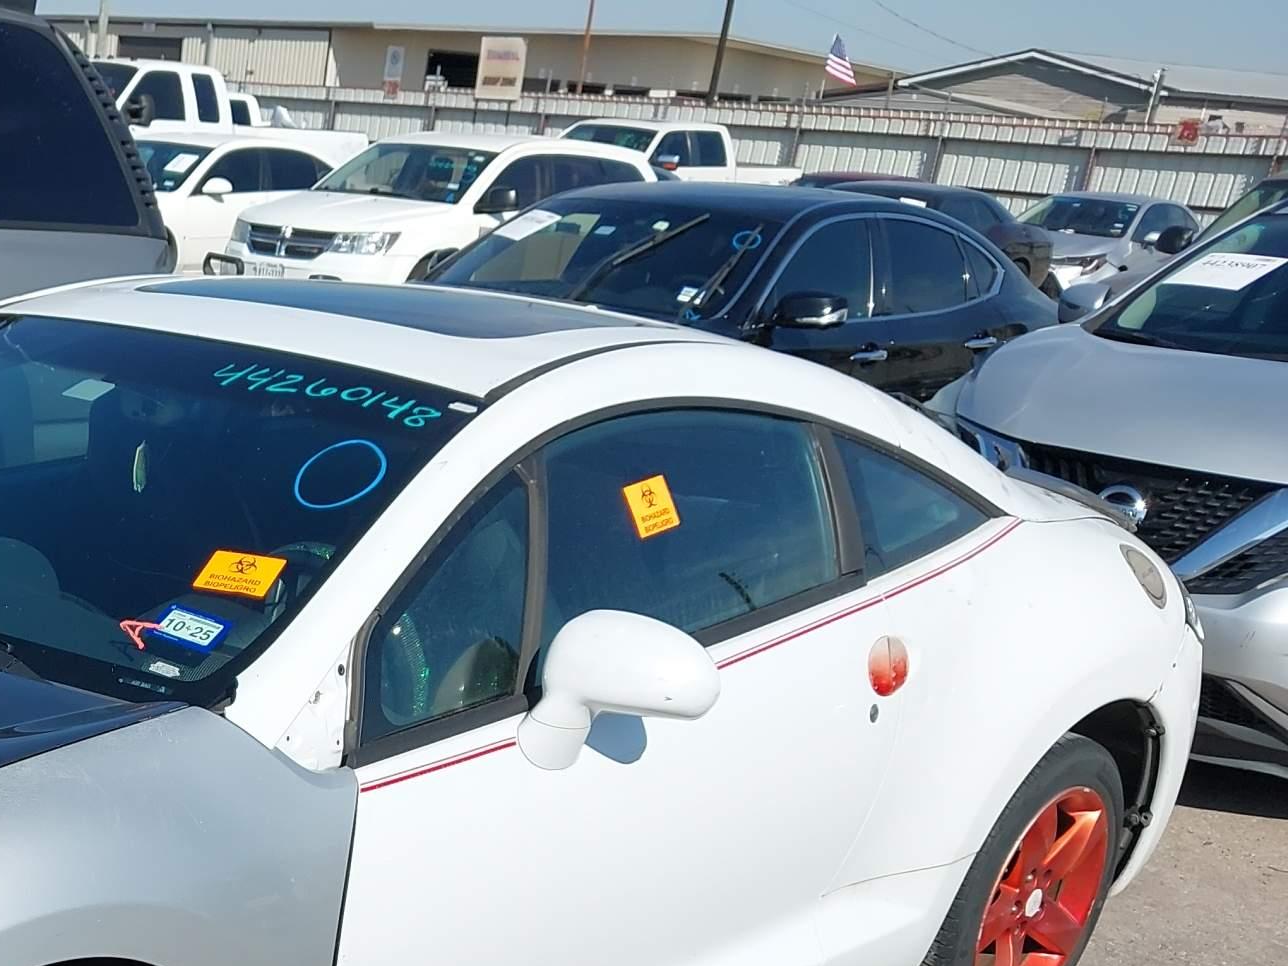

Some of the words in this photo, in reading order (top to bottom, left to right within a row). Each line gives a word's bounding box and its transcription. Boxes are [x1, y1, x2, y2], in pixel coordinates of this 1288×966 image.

[213, 363, 442, 427] 44260148
[208, 573, 262, 586] BIOHAZARD
[203, 580, 257, 593] BIOPELIGRO
